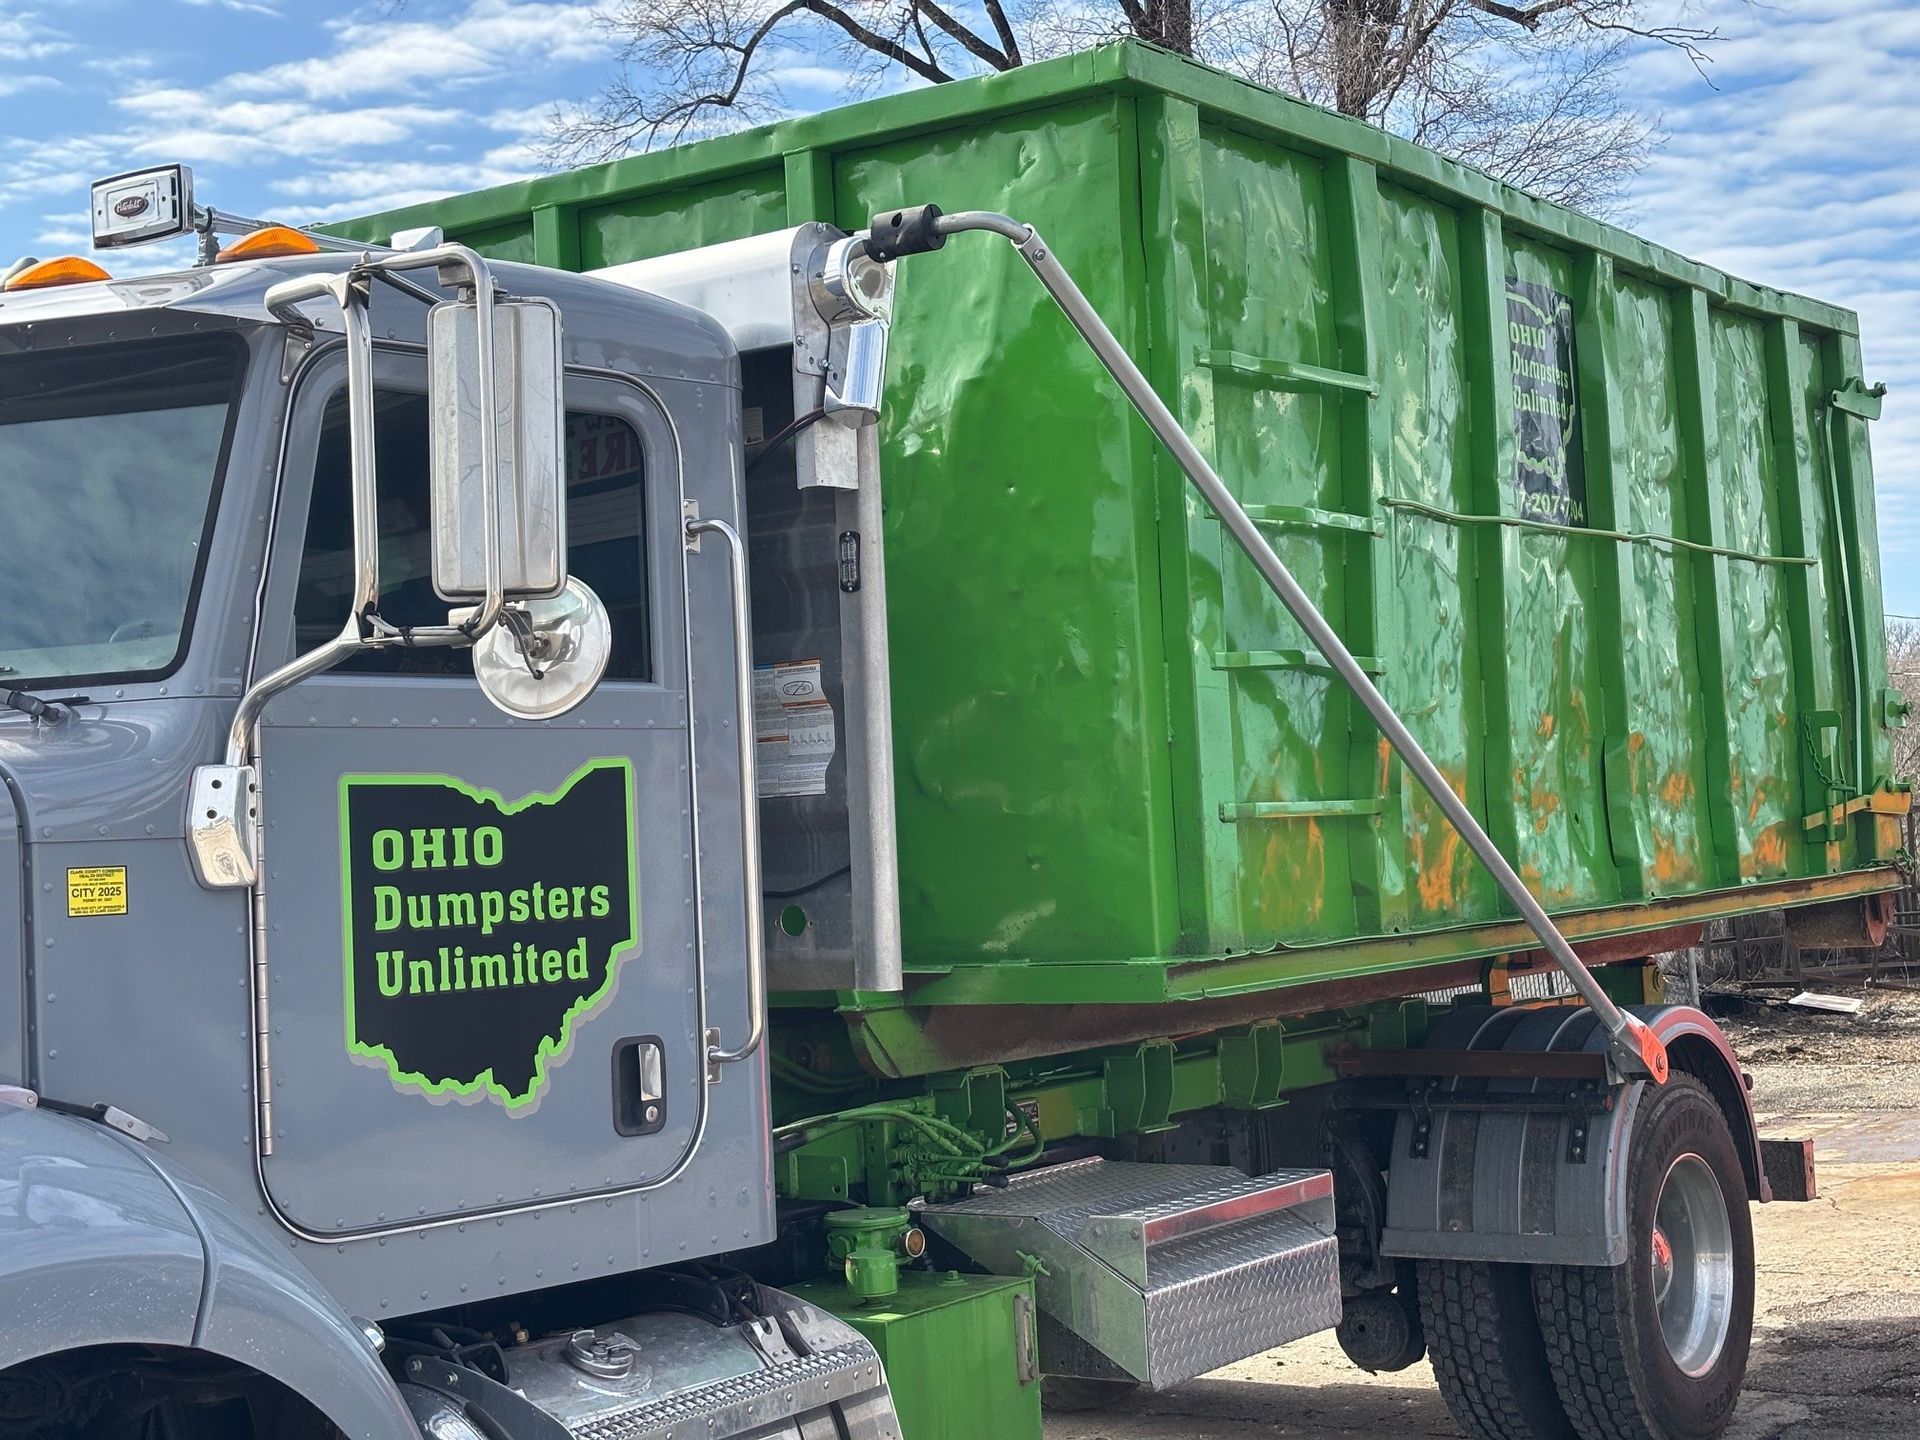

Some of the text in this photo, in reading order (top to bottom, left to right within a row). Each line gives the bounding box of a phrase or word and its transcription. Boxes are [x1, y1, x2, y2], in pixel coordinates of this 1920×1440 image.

[1509, 321, 1546, 351] OHIO
[1511, 351, 1569, 389] Dumpsters
[1513, 384, 1567, 421] Unlimited
[372, 826, 503, 871] OHIO
[71, 886, 122, 898] CITY 2025
[374, 881, 610, 935] Dumpsters
[376, 937, 589, 997] Unlimited
